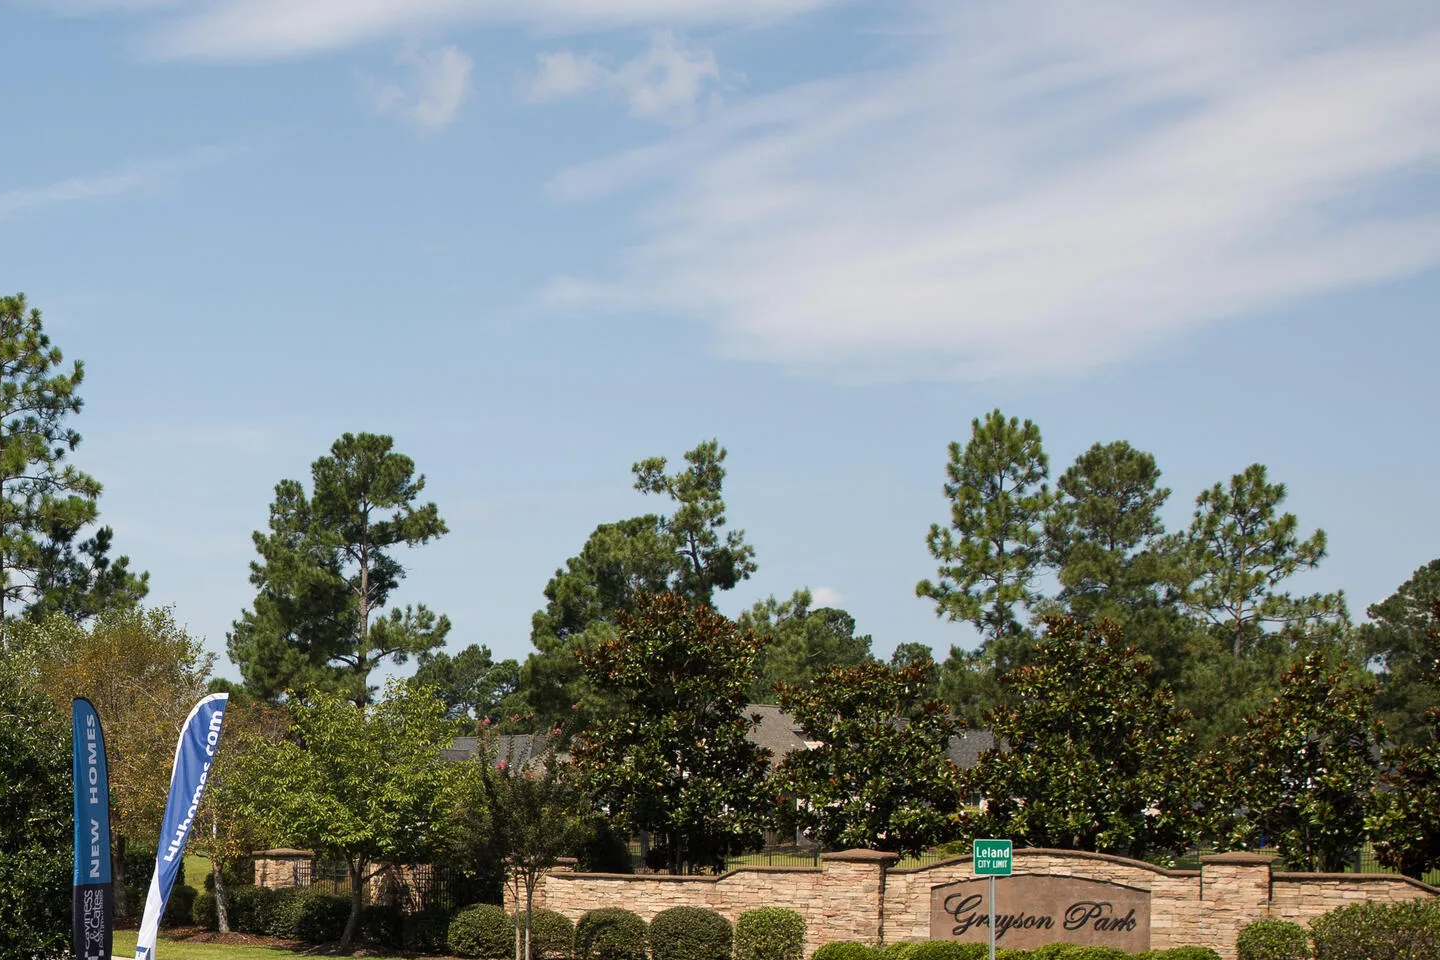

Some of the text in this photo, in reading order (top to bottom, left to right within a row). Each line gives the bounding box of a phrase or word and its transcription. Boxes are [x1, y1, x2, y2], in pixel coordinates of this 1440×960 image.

[86, 714, 100, 878] NEW HOMES
[976, 846, 1010, 859] Leland
[977, 860, 1008, 869] CITY LIMIT
[89, 889, 101, 942] & Cates
[944, 893, 1137, 940] Grayson Park
